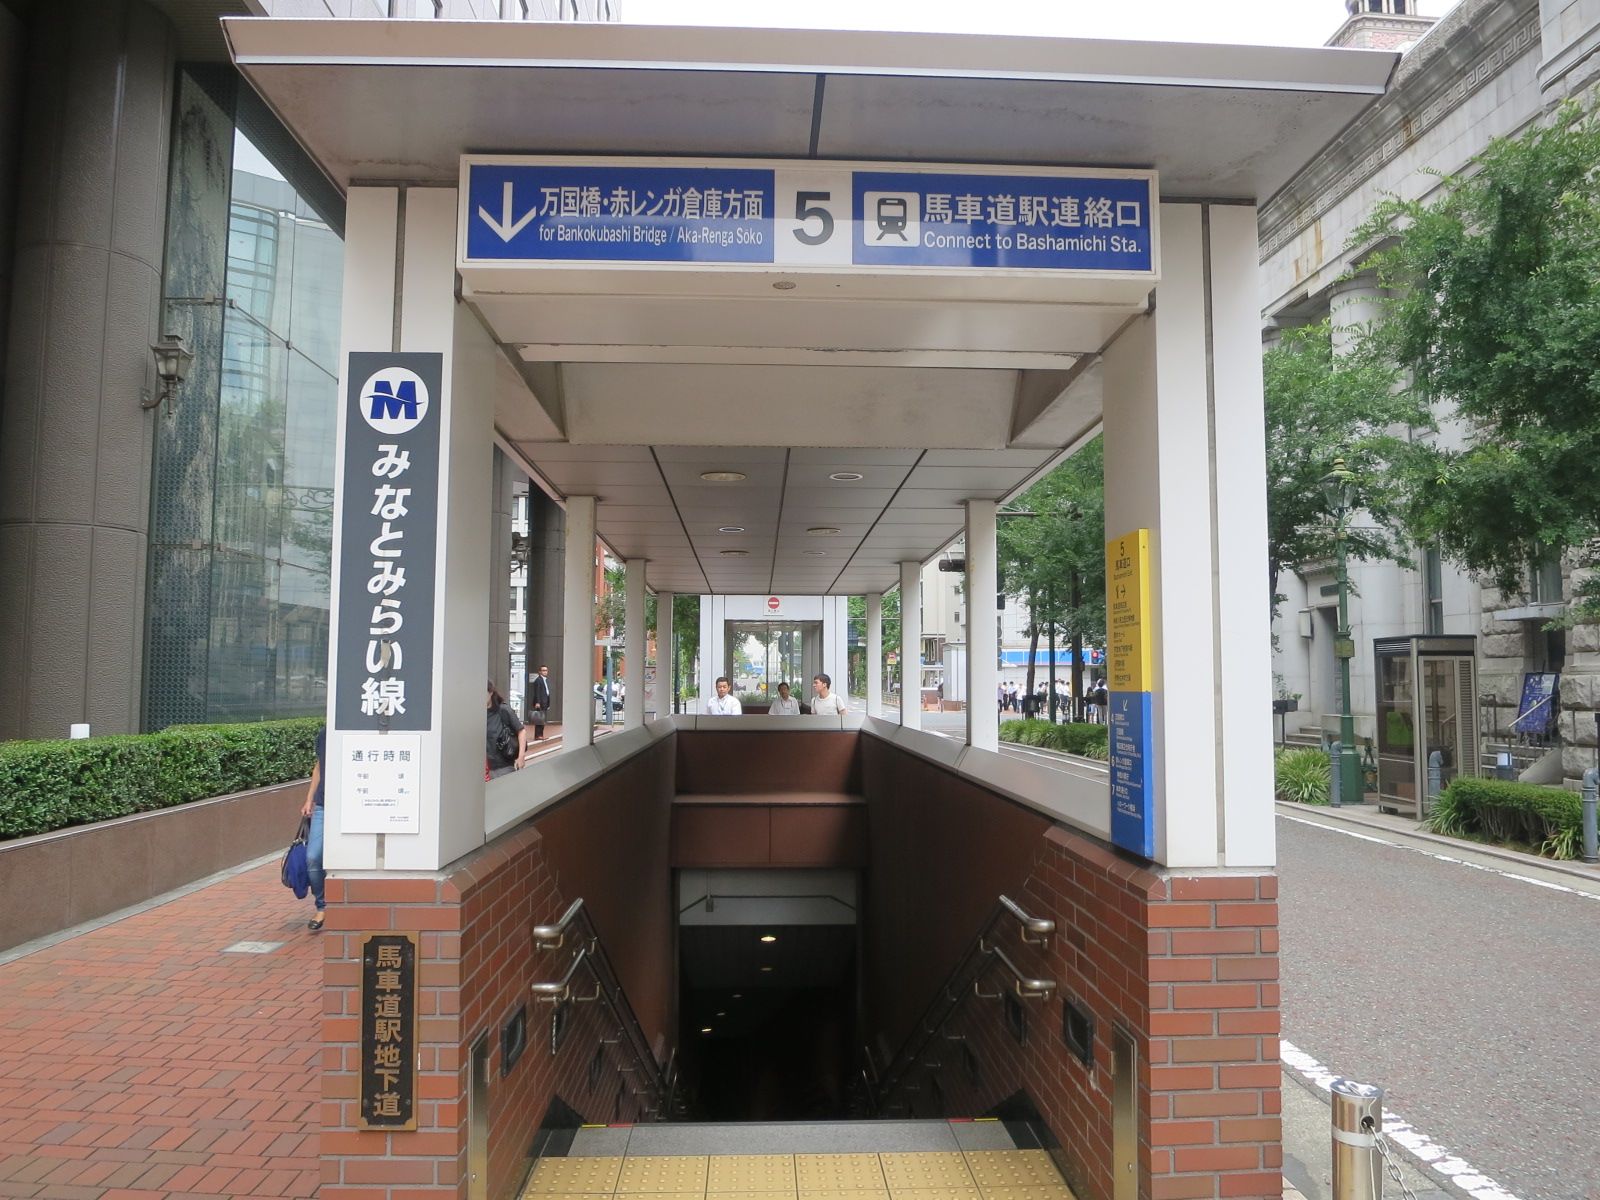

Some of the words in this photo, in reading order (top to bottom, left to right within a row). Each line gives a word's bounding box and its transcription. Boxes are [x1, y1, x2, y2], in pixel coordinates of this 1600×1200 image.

[540, 186, 764, 220] 万国橋・赤レンガ倉庫方面
[793, 191, 835, 246] 5
[924, 193, 1141, 228] 馬車道駅連絡口
[539, 224, 555, 241] for
[557, 225, 631, 242] Bankokubashi
[633, 225, 667, 246] Bridge
[677, 226, 734, 247] Aka-Renga
[924, 231, 991, 249] Connect
[995, 233, 1012, 249] to
[1016, 233, 1106, 252] Bashamichi
[1110, 235, 1142, 253] Sta.
[1120, 541, 1125, 556] 5
[361, 444, 412, 717] みなとみらい線
[352, 750, 411, 762] 通行時間
[374, 945, 402, 1117] 馬車道駅地下道
